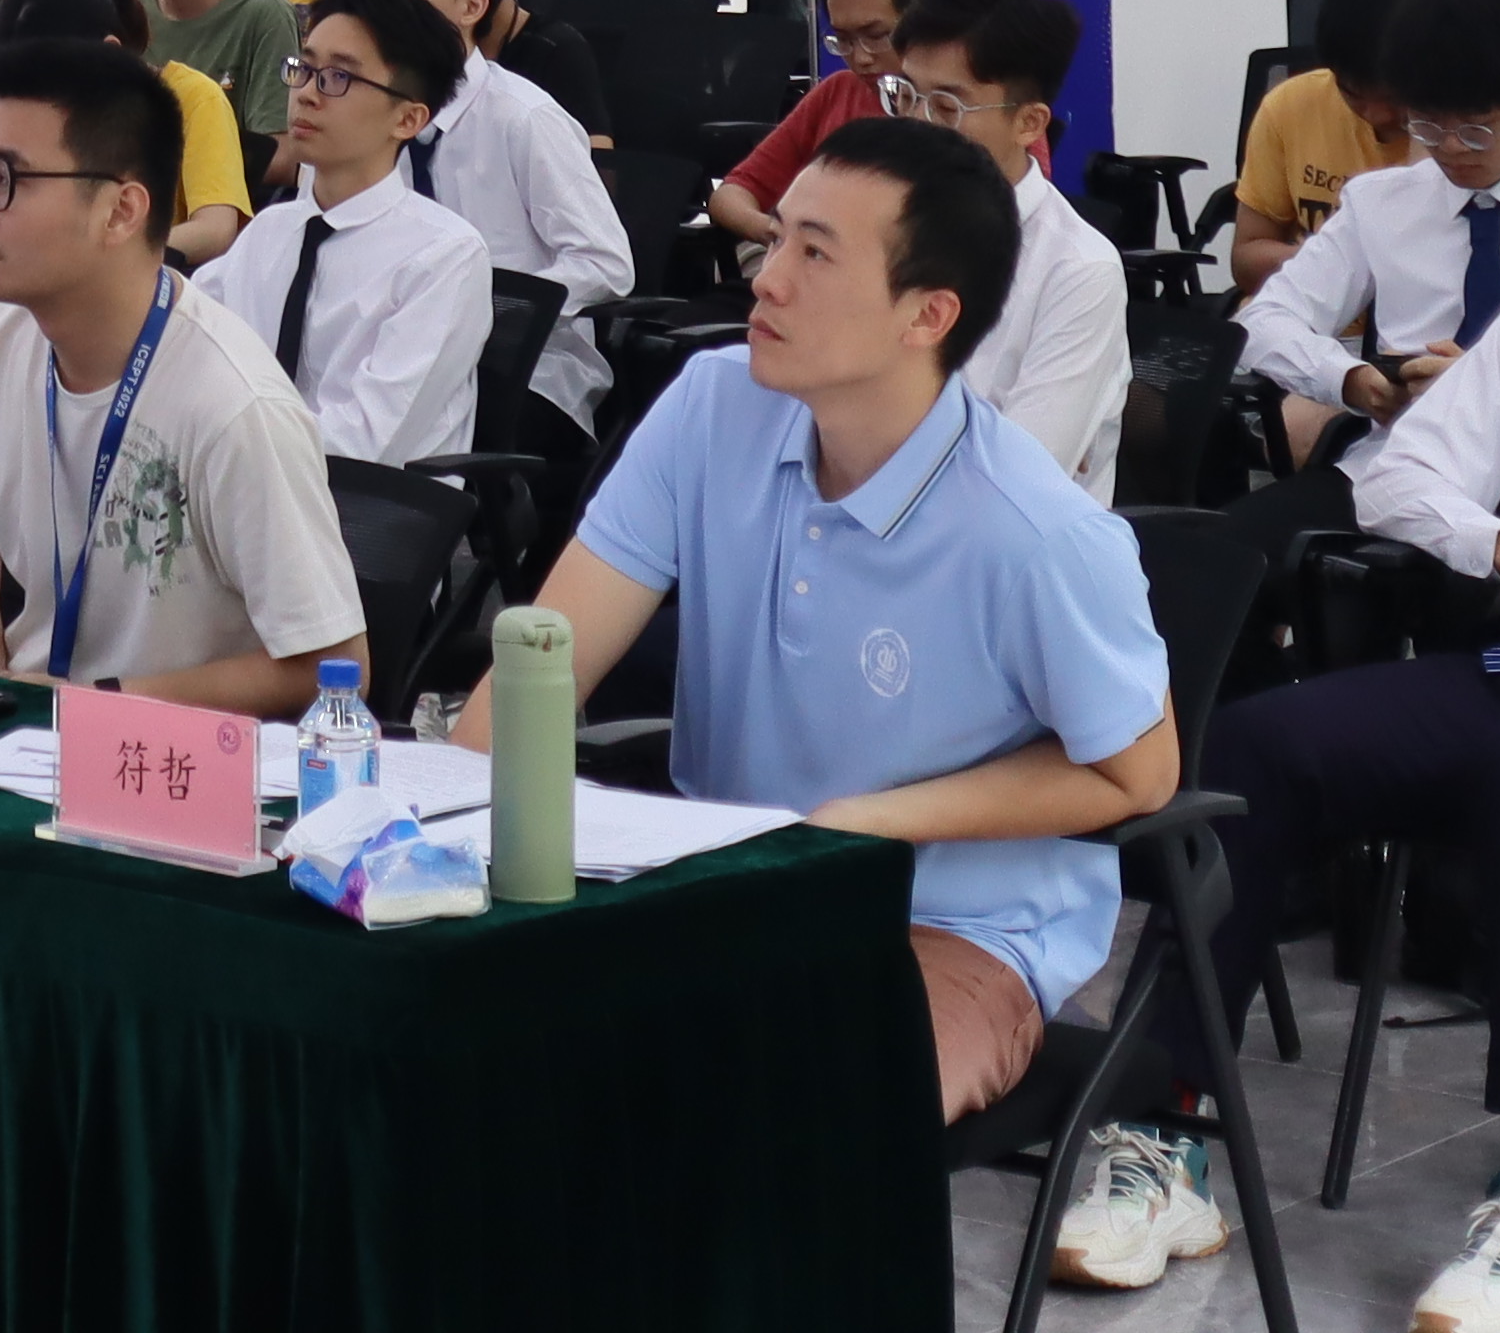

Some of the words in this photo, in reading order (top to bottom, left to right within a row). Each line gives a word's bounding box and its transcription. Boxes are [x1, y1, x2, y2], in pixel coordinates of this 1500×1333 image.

[1303, 164, 1347, 193] SEC
[127, 343, 151, 386] ICEPT
[113, 385, 134, 418] 2022
[114, 739, 197, 801] 符哲
